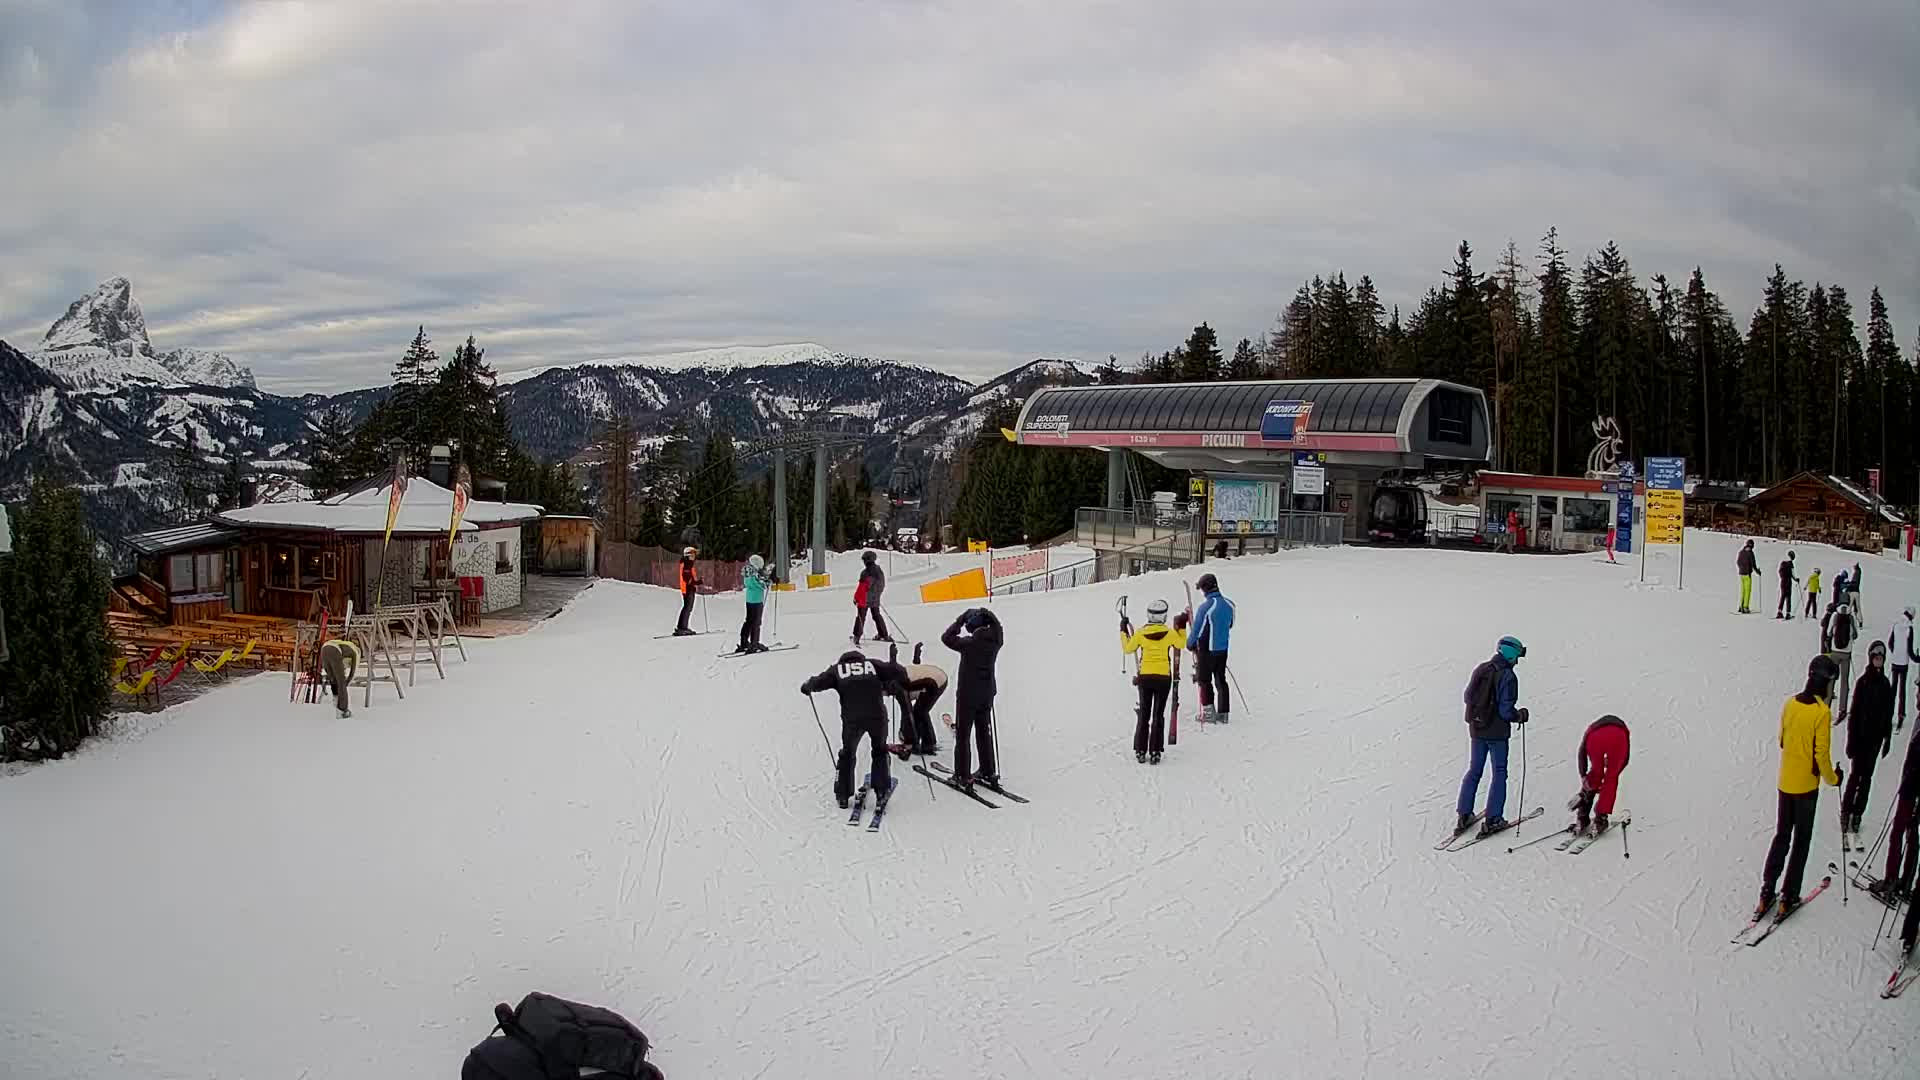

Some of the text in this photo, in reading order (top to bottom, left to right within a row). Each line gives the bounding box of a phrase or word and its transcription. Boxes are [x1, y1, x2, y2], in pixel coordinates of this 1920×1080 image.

[1265, 405, 1311, 413] KRONPLATZ
[1025, 422, 1058, 430] SUPERSKI
[1201, 434, 1245, 447] PICULIN
[837, 660, 877, 679] USA
